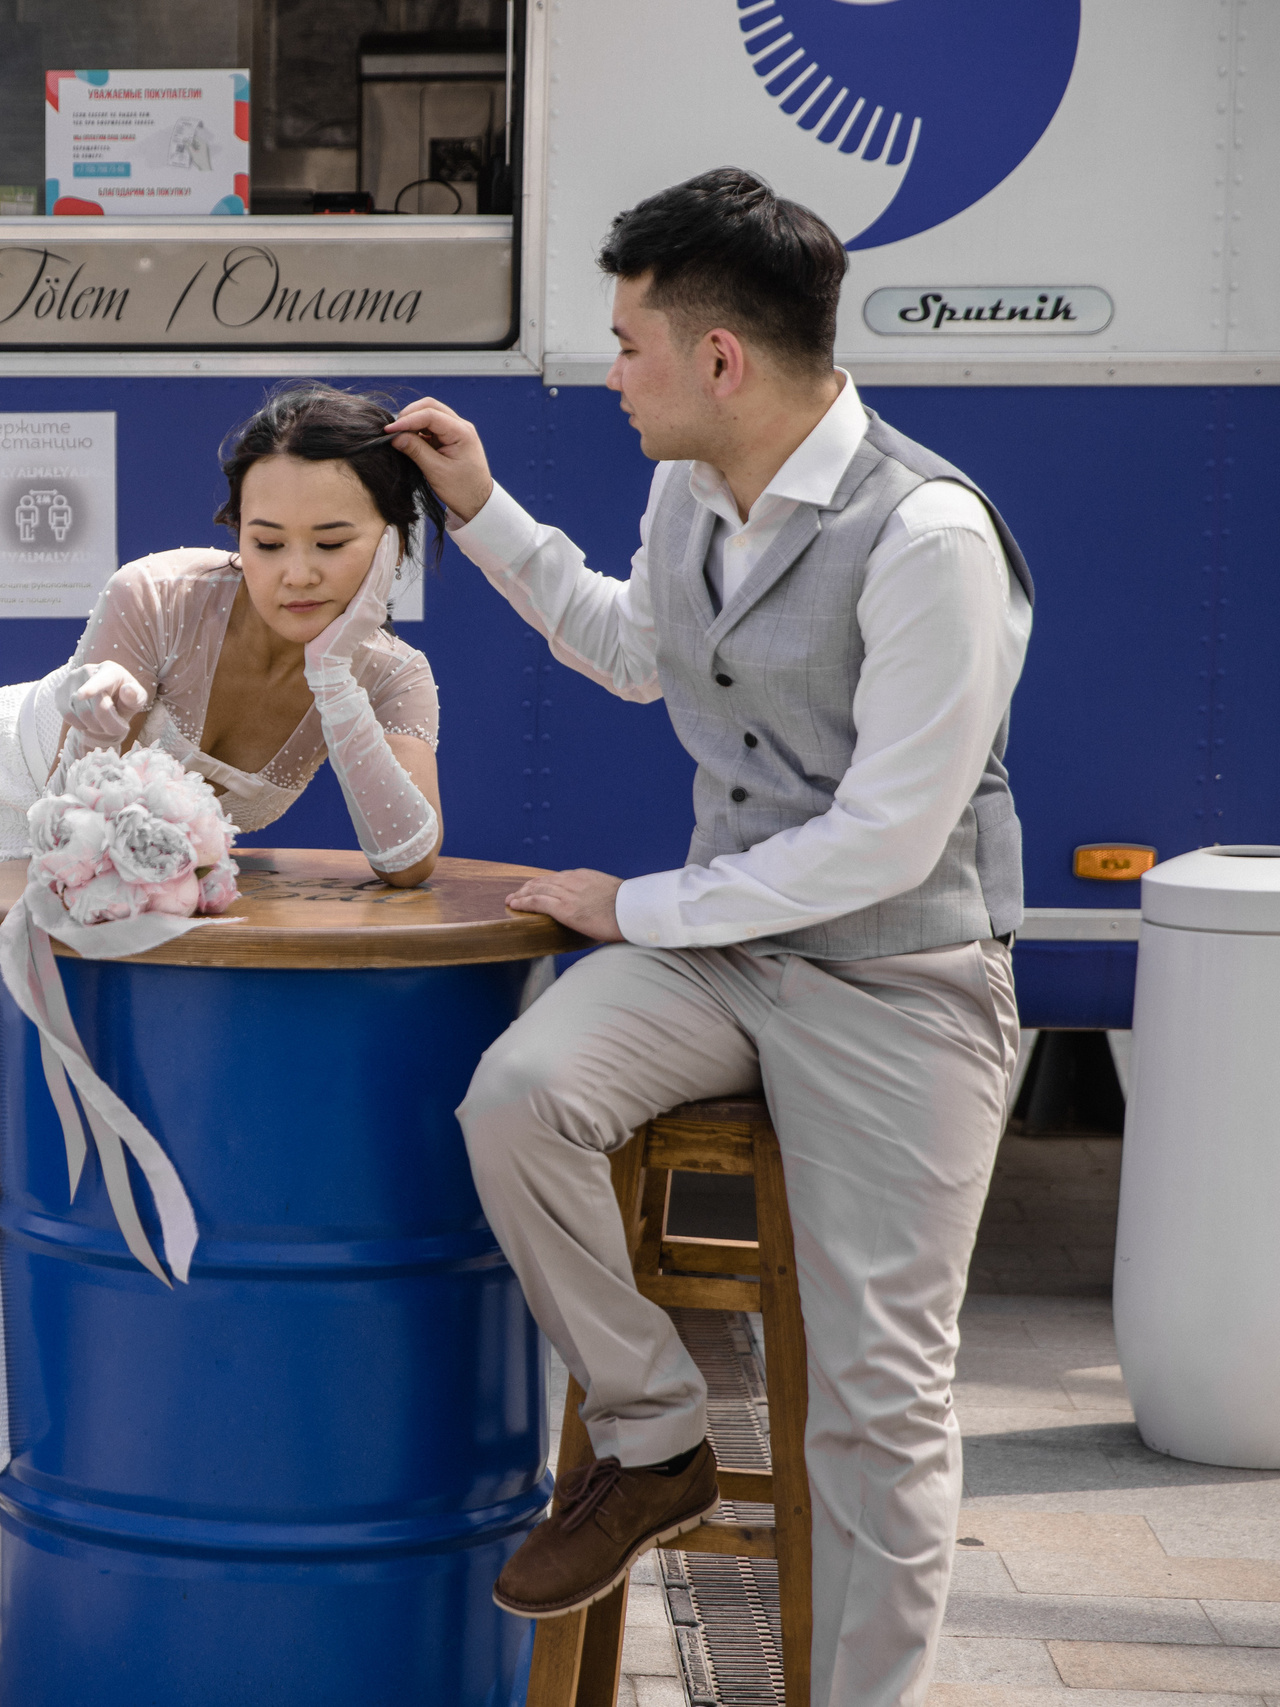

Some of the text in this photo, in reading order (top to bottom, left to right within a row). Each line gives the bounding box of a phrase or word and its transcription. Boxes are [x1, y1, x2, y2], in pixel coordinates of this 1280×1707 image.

[88, 88, 142, 100] УВАЖАЕМЫЕ
[98, 187, 144, 197] БЛАГОДАРИМ
[146, 187, 155, 197] ЗА
[212, 245, 424, 328] Оплата
[899, 292, 1077, 329] Sputnik
